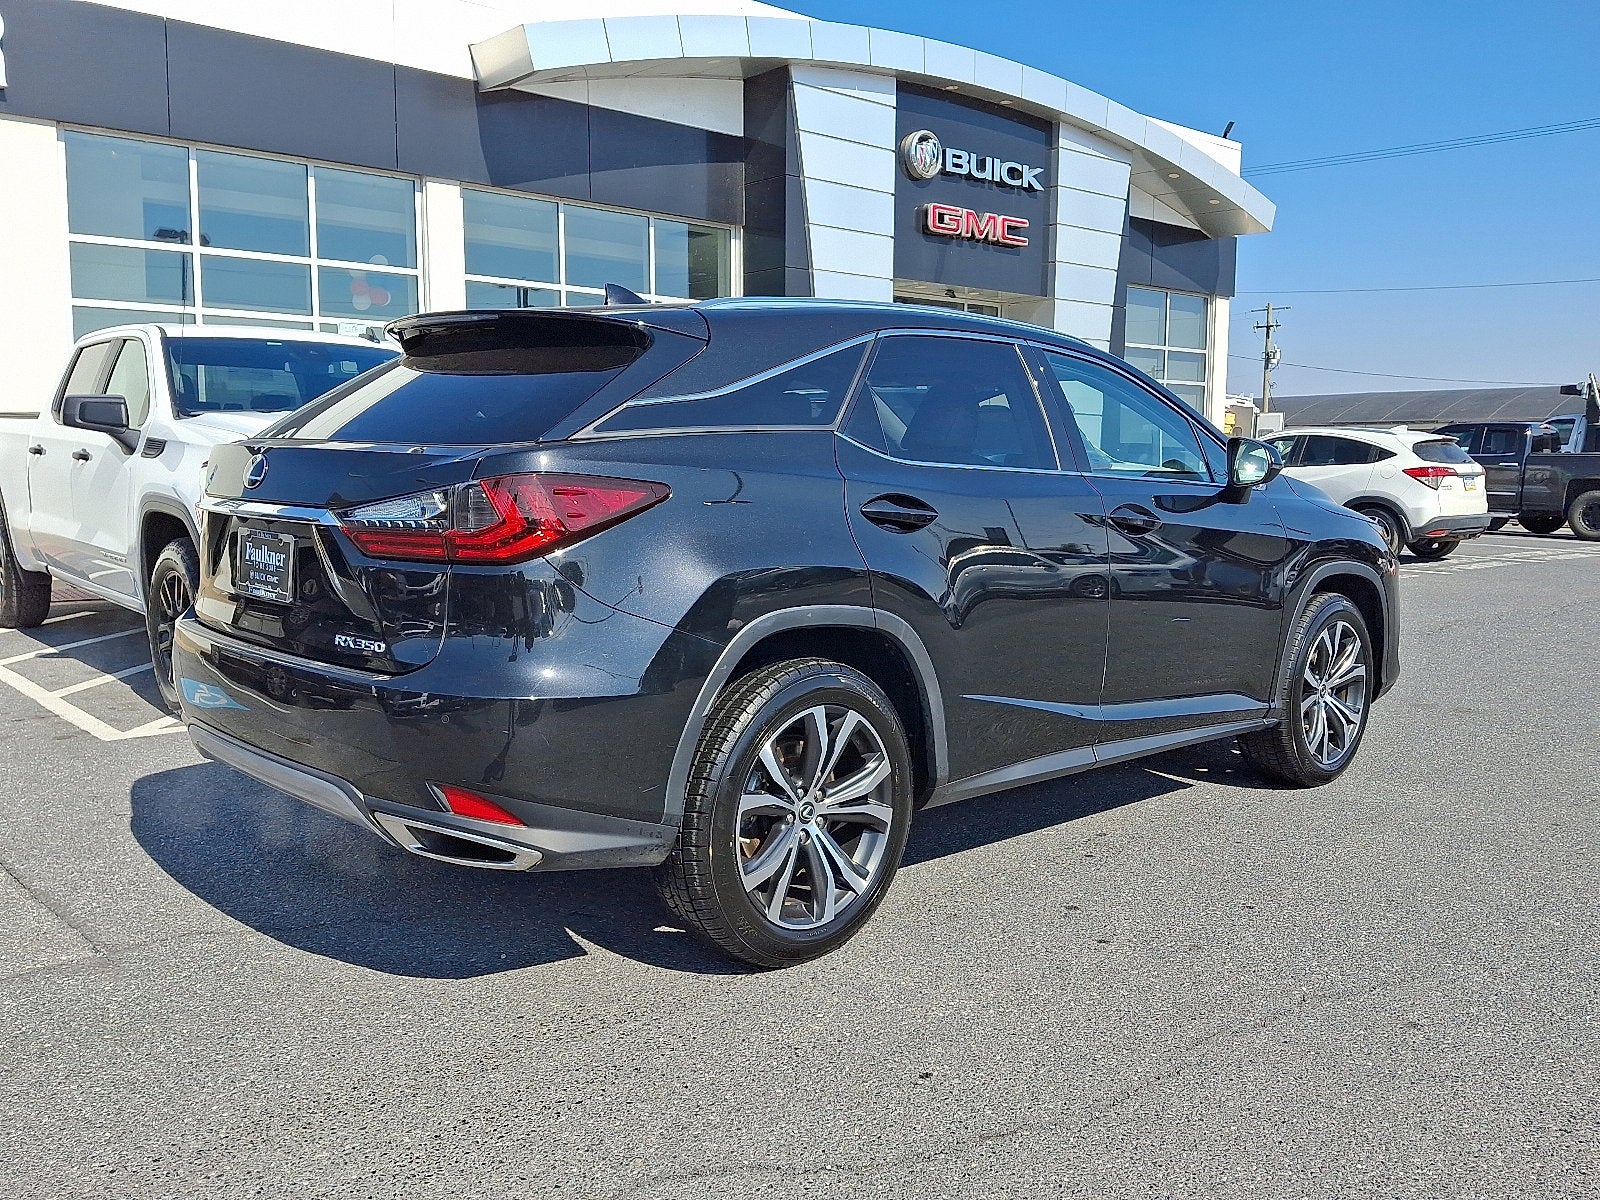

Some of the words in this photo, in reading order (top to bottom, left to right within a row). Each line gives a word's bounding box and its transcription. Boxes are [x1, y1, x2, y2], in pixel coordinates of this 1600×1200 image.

[945, 148, 1044, 191] BUICK
[927, 202, 1029, 246] GMC
[245, 542, 285, 566] Faulkner
[248, 586, 277, 598] Faulkner
[334, 634, 385, 652] RX350
